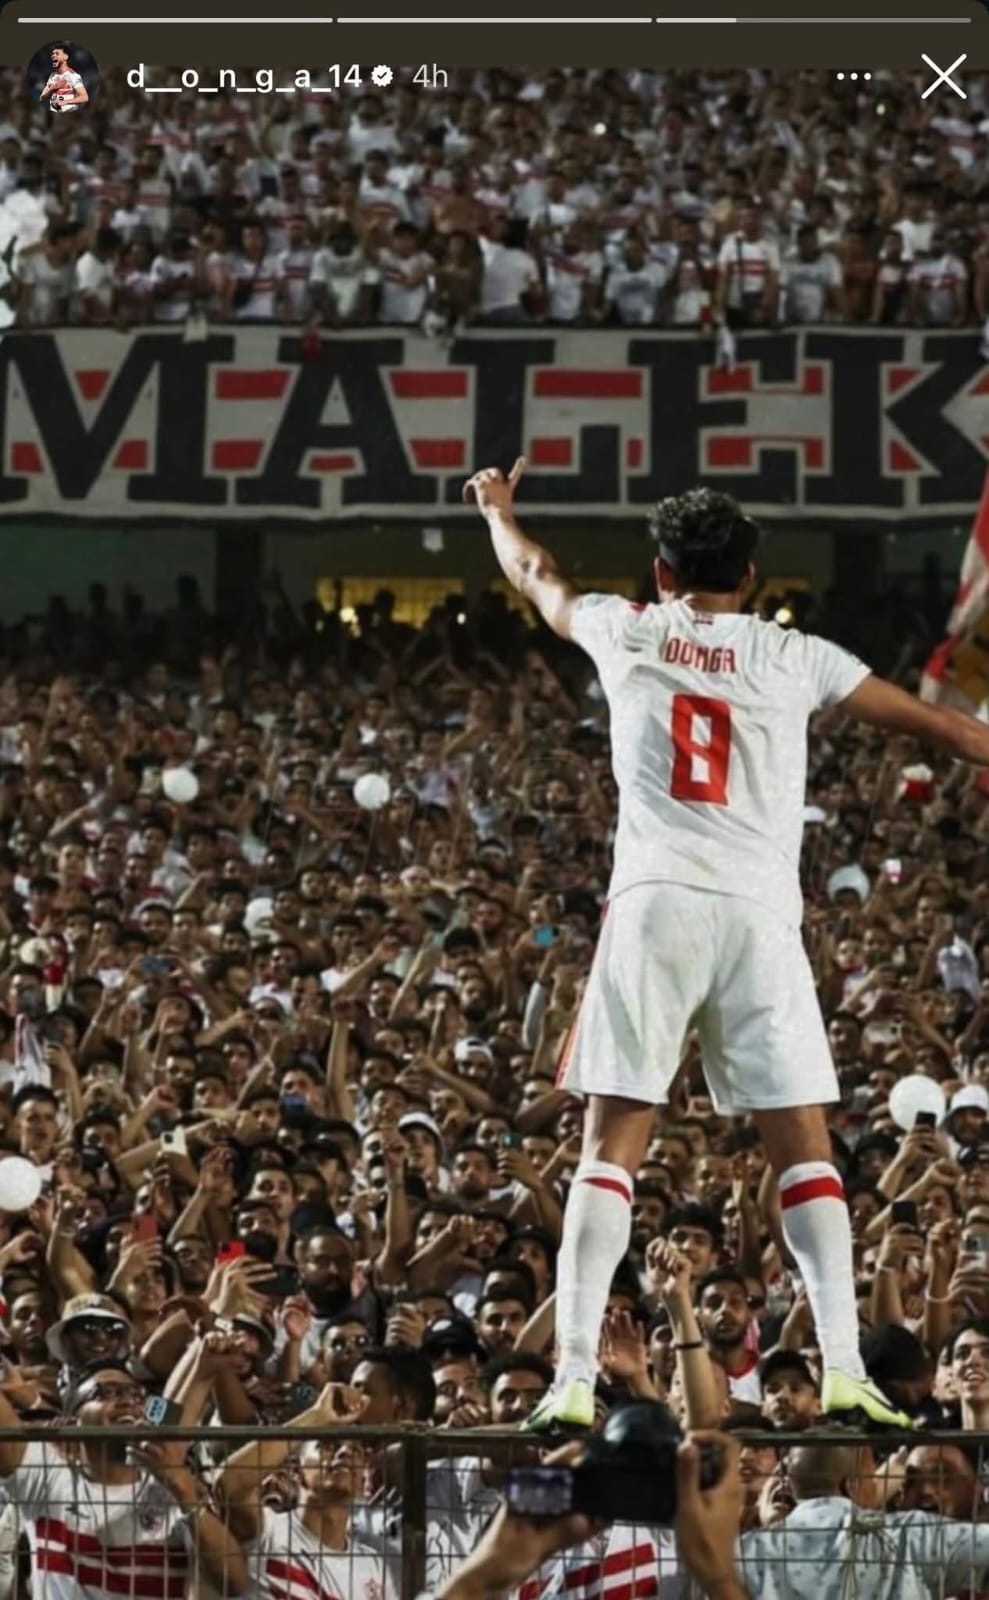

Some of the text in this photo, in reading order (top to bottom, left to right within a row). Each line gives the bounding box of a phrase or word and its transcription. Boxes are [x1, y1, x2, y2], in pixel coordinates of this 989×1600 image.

[0, 331, 989, 507] MALEK
[664, 636, 736, 674] DUNGA
[670, 693, 732, 806] 8
